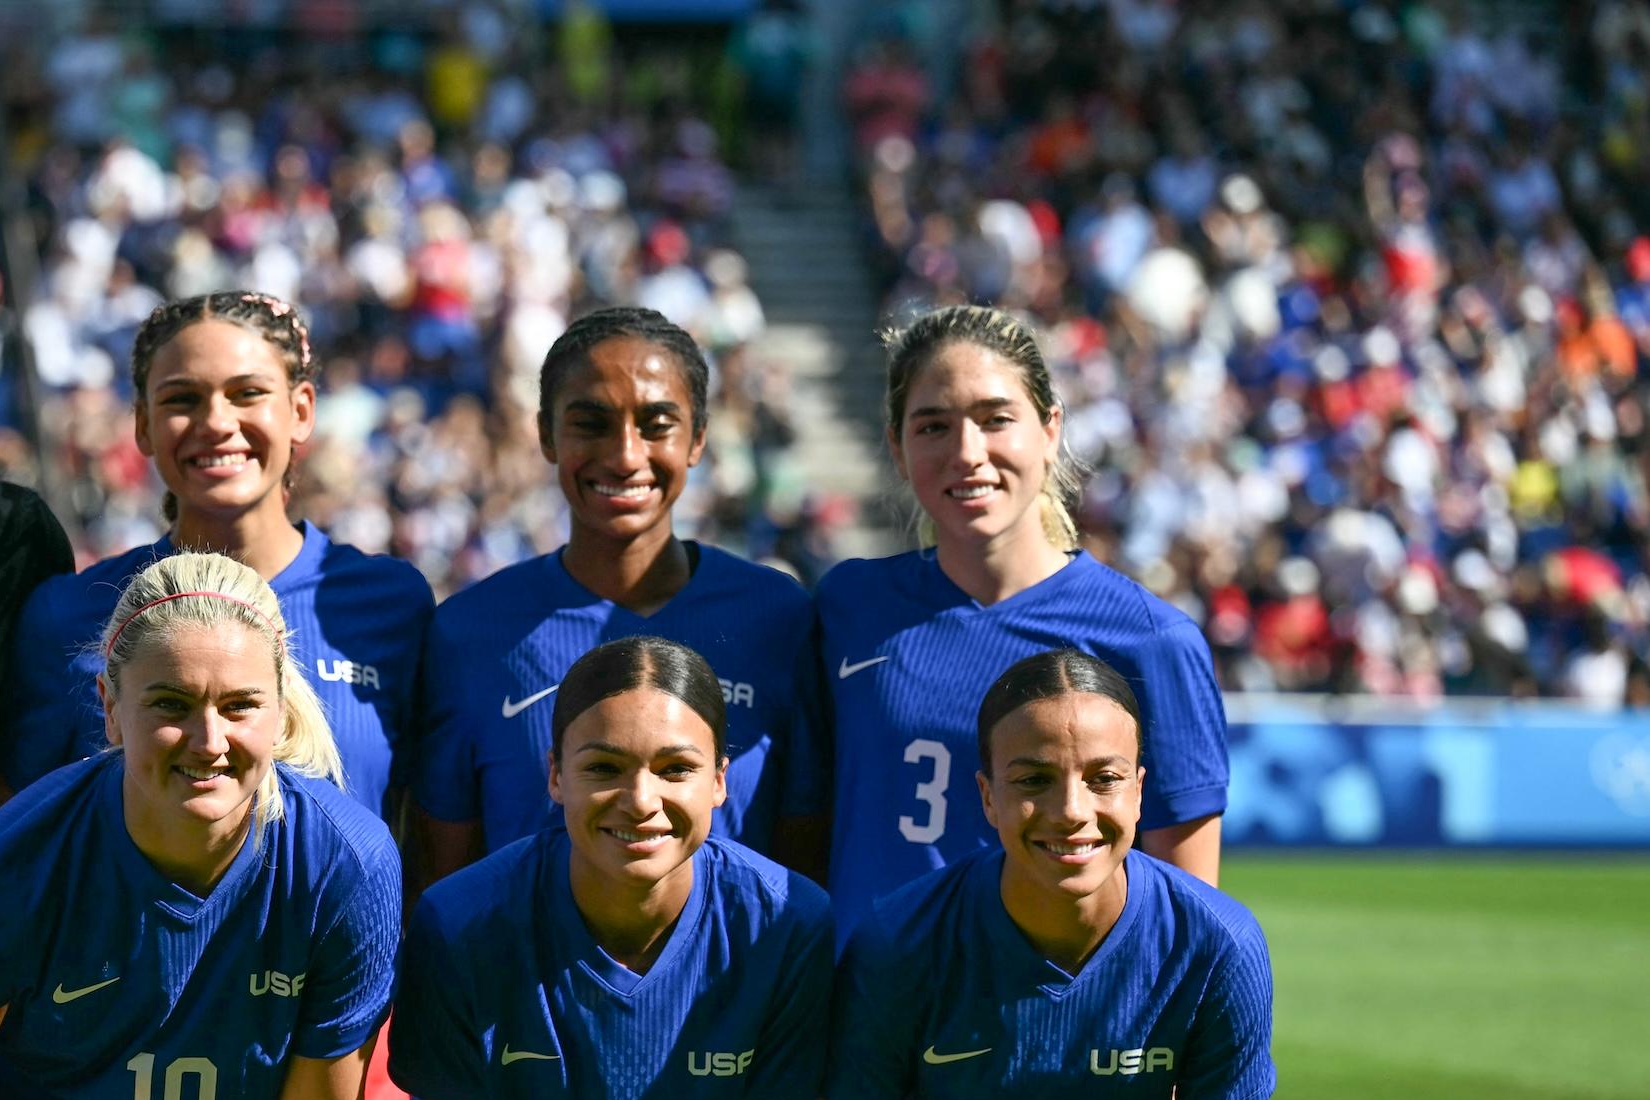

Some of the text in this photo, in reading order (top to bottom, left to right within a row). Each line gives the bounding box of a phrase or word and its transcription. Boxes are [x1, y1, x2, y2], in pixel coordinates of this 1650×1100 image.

[316, 658, 381, 691] USA
[717, 677, 755, 708] SA
[898, 738, 952, 844] 3
[1089, 1047, 1174, 1076] USA
